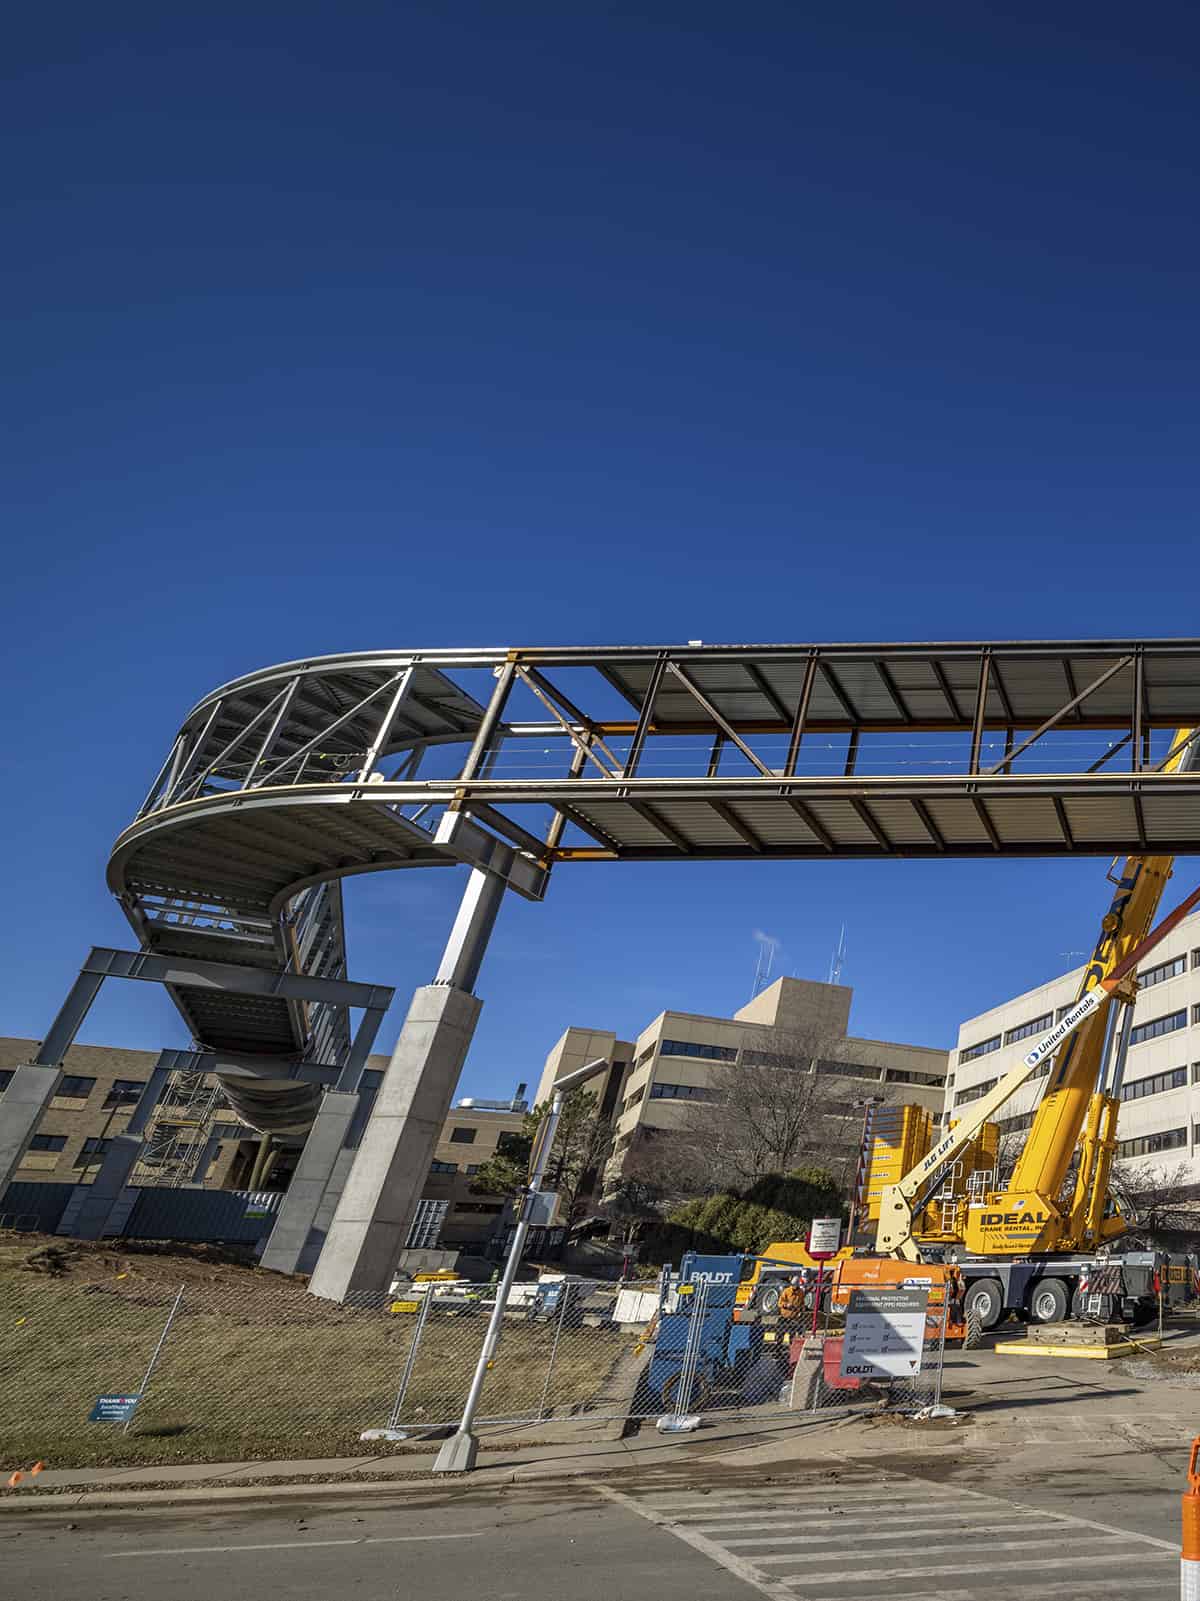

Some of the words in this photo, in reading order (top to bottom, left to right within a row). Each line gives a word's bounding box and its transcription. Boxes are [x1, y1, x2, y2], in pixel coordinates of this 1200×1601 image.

[1038, 1025, 1067, 1054] United
[1065, 997, 1095, 1028] Rentals
[923, 1154, 938, 1172] JLG
[938, 1135, 955, 1157] LIFT
[981, 1212, 1048, 1225] IDEAL
[690, 1271, 734, 1283] BOLDT
[846, 1365, 873, 1374] BOLDT
